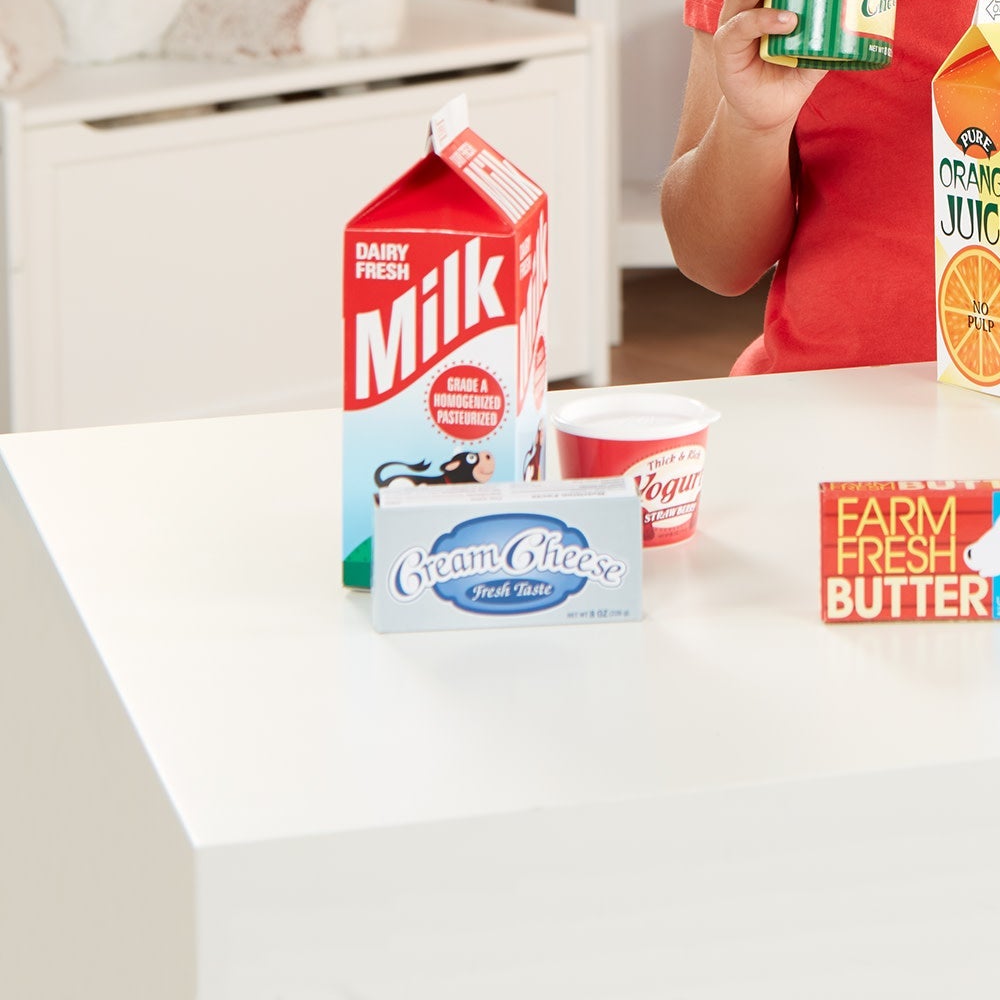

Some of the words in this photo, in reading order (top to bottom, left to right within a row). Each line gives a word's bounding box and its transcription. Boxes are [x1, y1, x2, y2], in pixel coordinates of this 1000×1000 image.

[960, 129, 993, 153] PURE
[355, 242, 410, 262] DAIRY
[355, 261, 410, 281] FRESH
[355, 235, 506, 400] Milk
[972, 300, 989, 316] NO
[967, 315, 995, 333] PULP
[447, 377, 479, 392] GRADE
[480, 378, 488, 393] A
[433, 393, 501, 410] HOMOGENIZED
[437, 410, 498, 426] PASTEURIZED
[648, 453, 676, 471] Thick
[678, 451, 685, 462] &
[836, 495, 957, 537] FARM
[388, 546, 500, 602] Cream
[502, 526, 628, 588] Cheese
[837, 535, 956, 575] FRESH
[471, 583, 511, 601] Fresh
[513, 582, 552, 597] Taste
[826, 575, 989, 619] BUTTER
